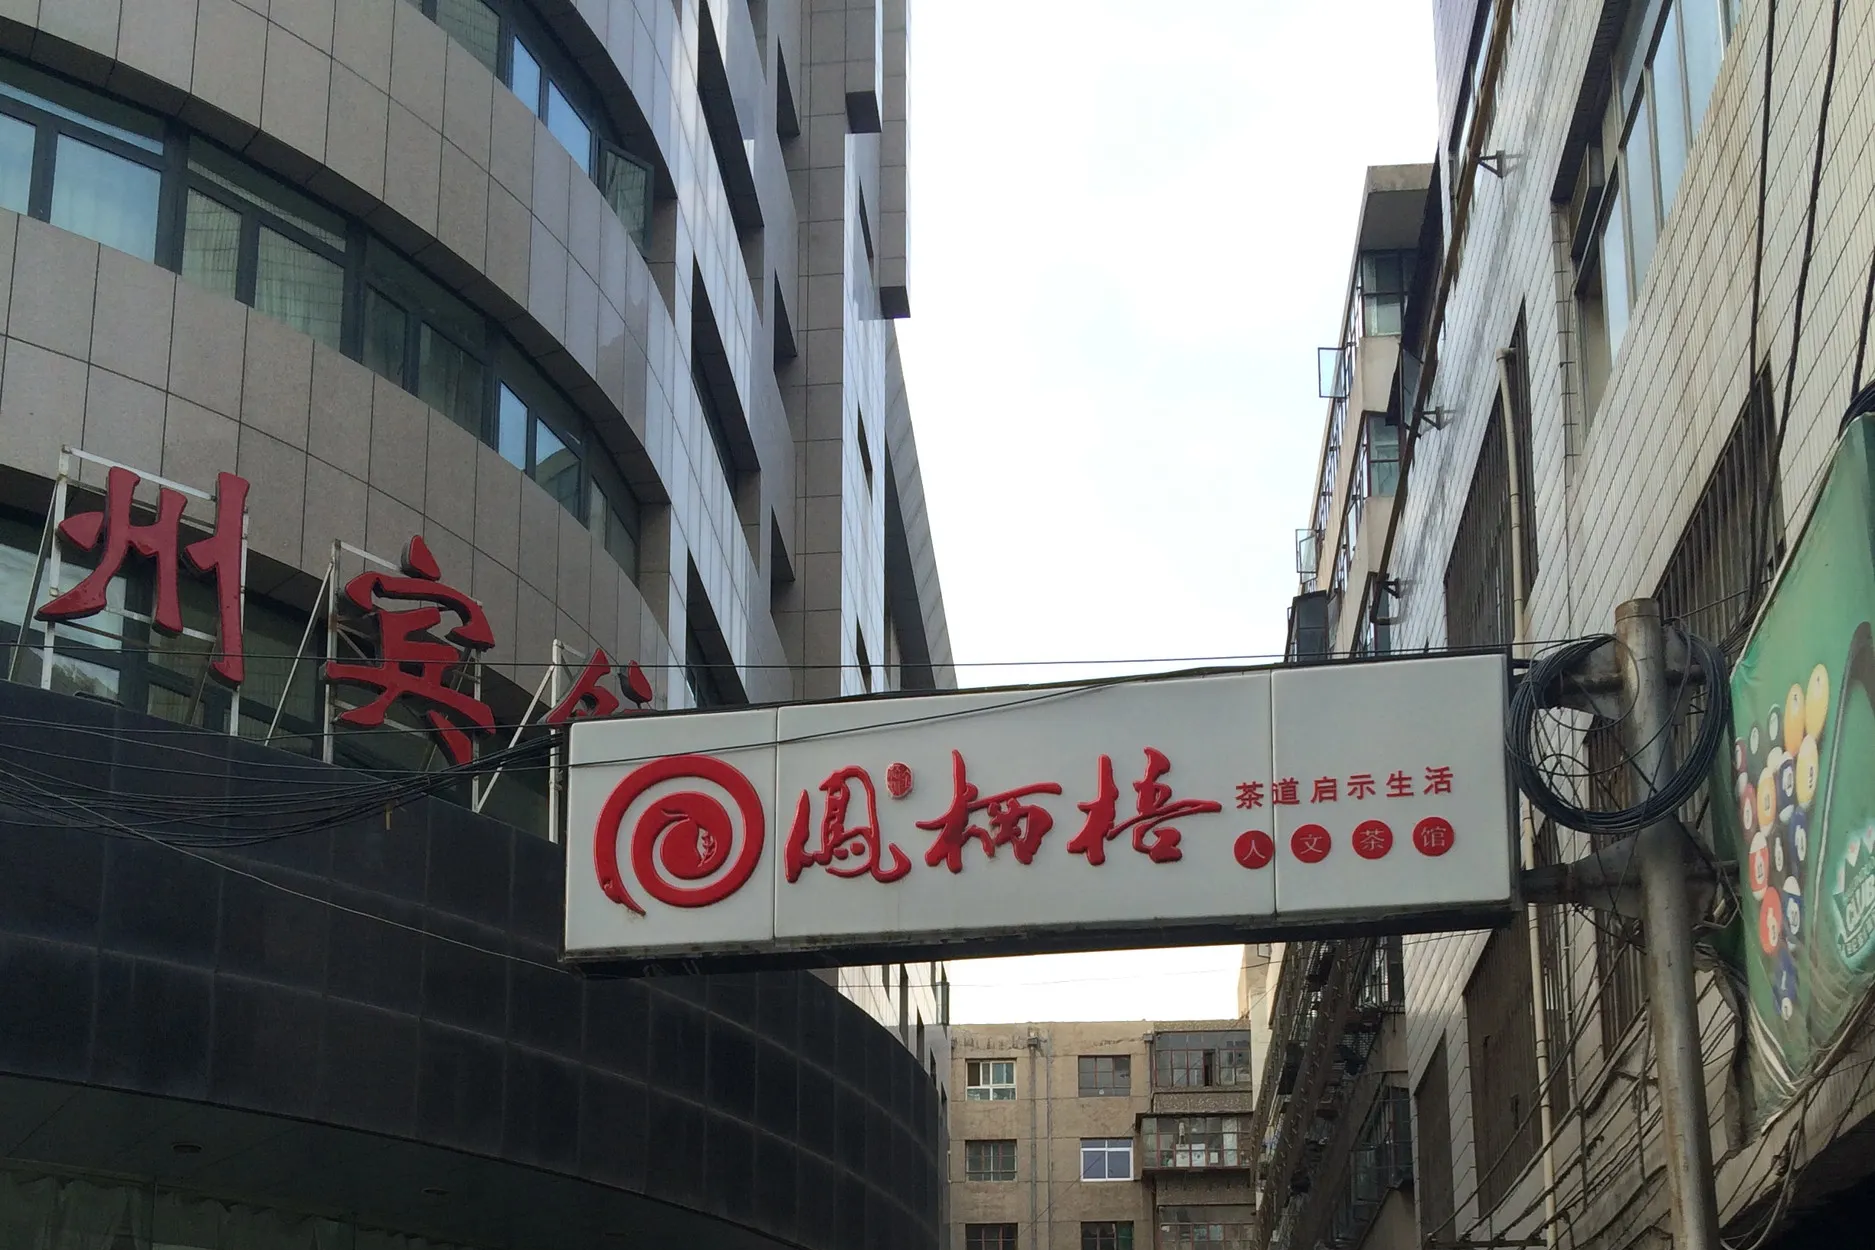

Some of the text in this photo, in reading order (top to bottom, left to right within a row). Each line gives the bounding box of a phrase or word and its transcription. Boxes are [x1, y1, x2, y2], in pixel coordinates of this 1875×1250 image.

[1235, 766, 1454, 810] 茶道启示生活
[1240, 824, 1449, 863] 人文茶馆
